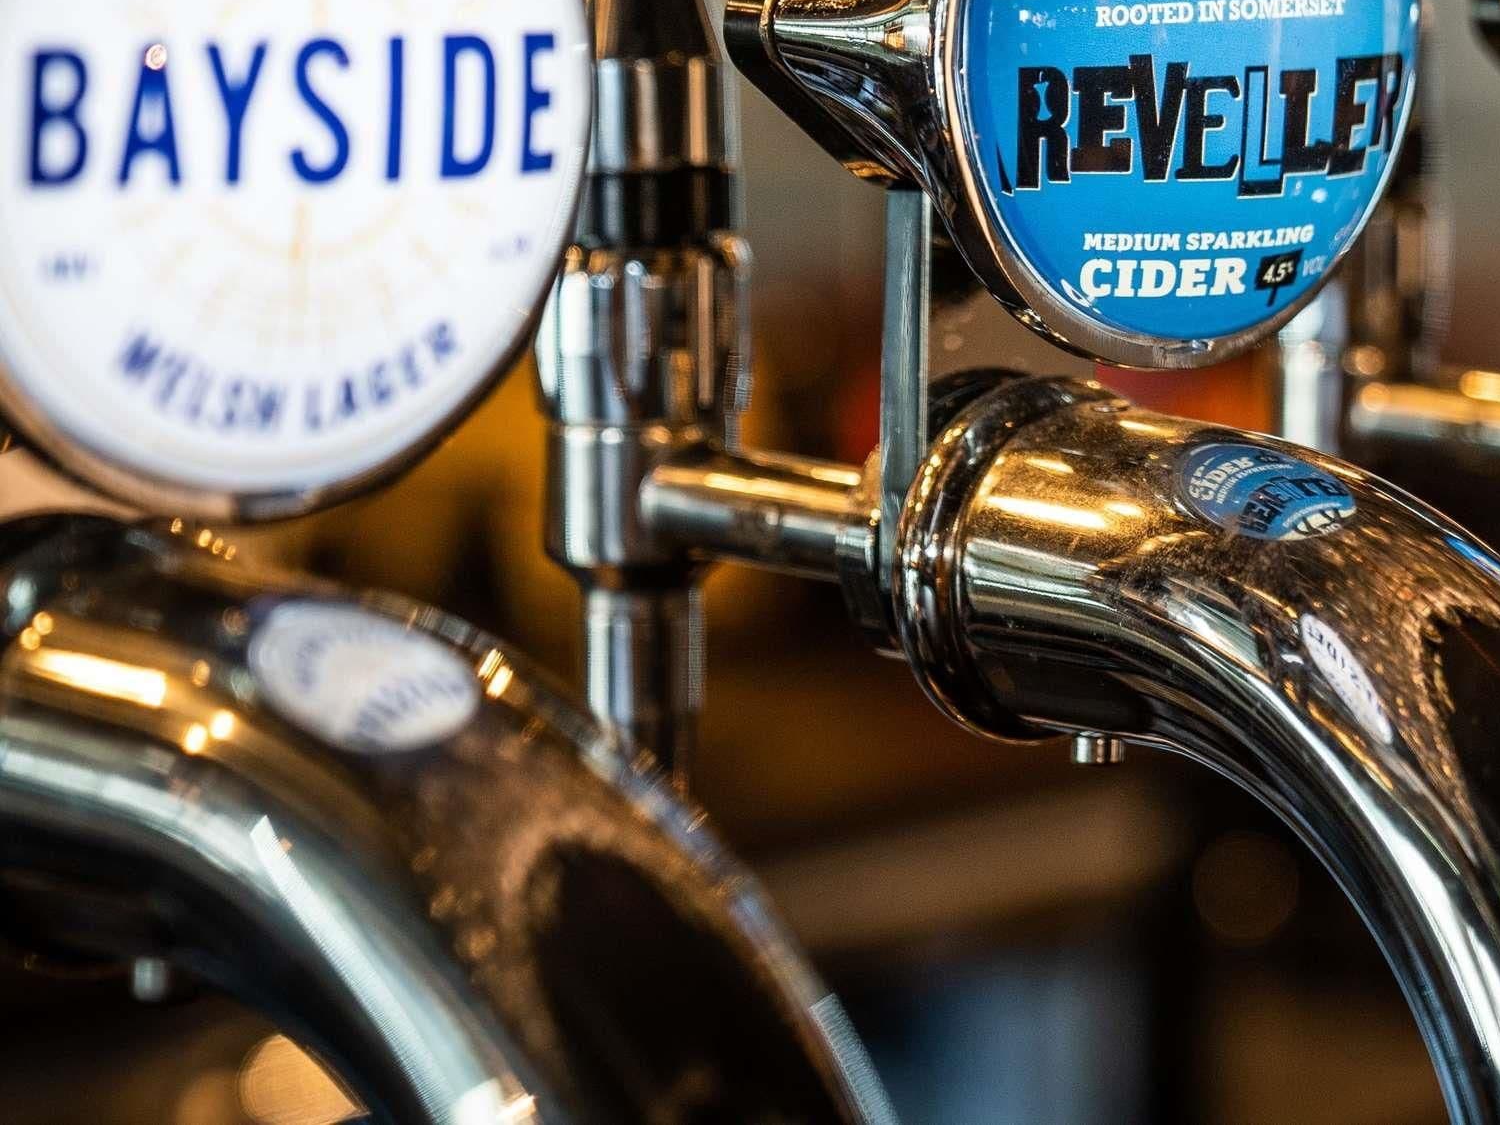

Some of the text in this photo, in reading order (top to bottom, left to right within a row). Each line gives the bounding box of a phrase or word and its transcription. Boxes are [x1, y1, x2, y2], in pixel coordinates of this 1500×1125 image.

[1095, 2, 1194, 27] ROOTED
[28, 33, 556, 190] BAYSIDE
[1015, 53, 1402, 198] REVELLER
[1083, 224, 1315, 252] MEDIUM SPARKLING
[1079, 257, 1248, 298] CIDER
[303, 321, 466, 436] LAGER
